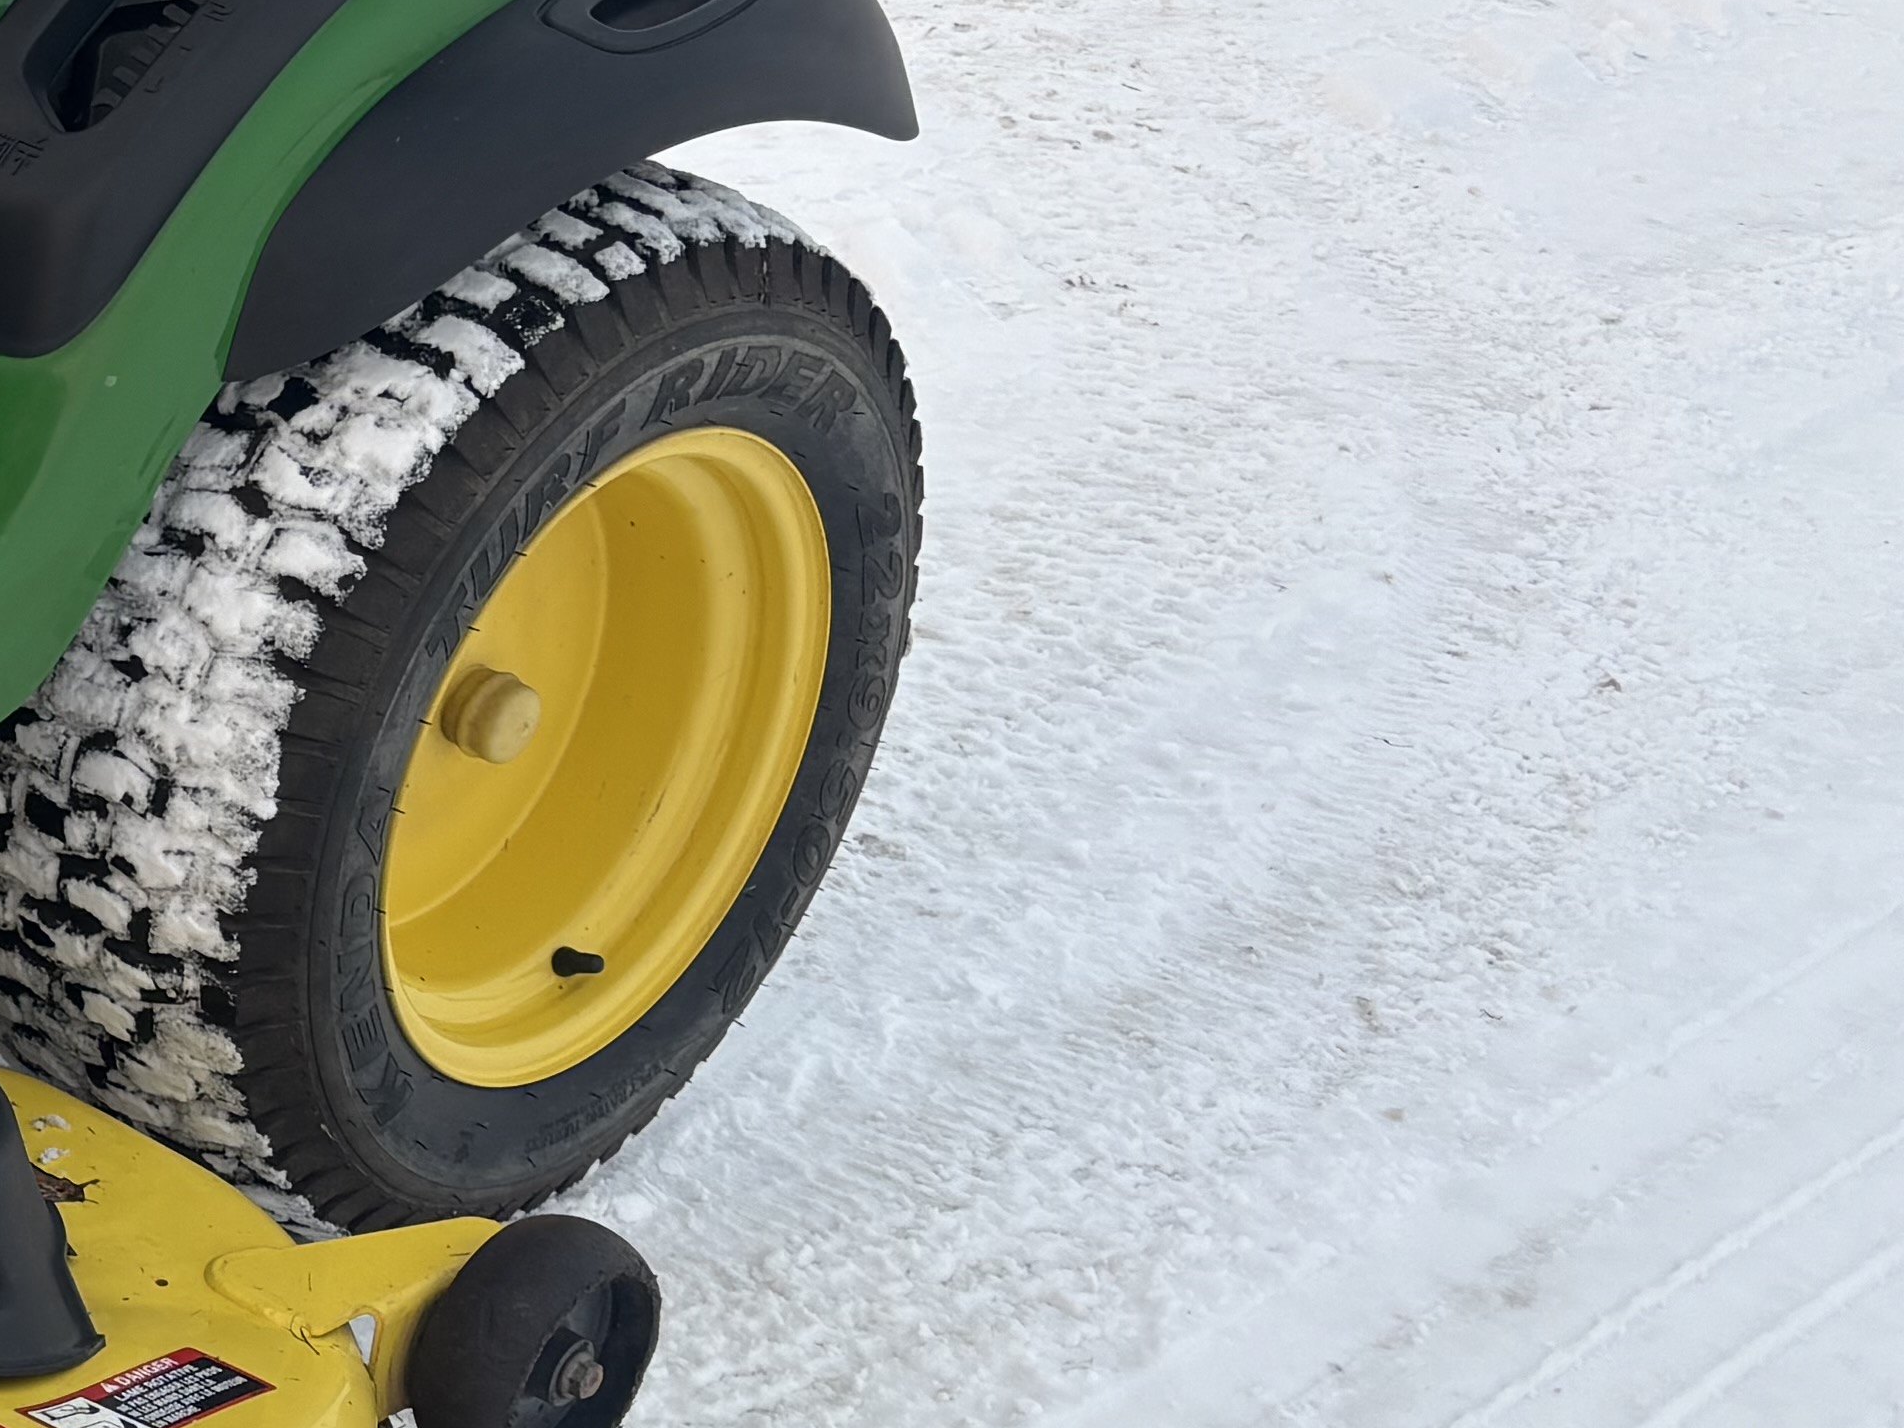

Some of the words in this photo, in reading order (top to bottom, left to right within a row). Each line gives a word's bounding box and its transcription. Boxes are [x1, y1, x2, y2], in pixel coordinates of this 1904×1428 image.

[426, 396, 632, 664] TURF
[642, 343, 861, 434] RIDER
[332, 808, 416, 1130] KENDA
[113, 1357, 180, 1386] DANGER
